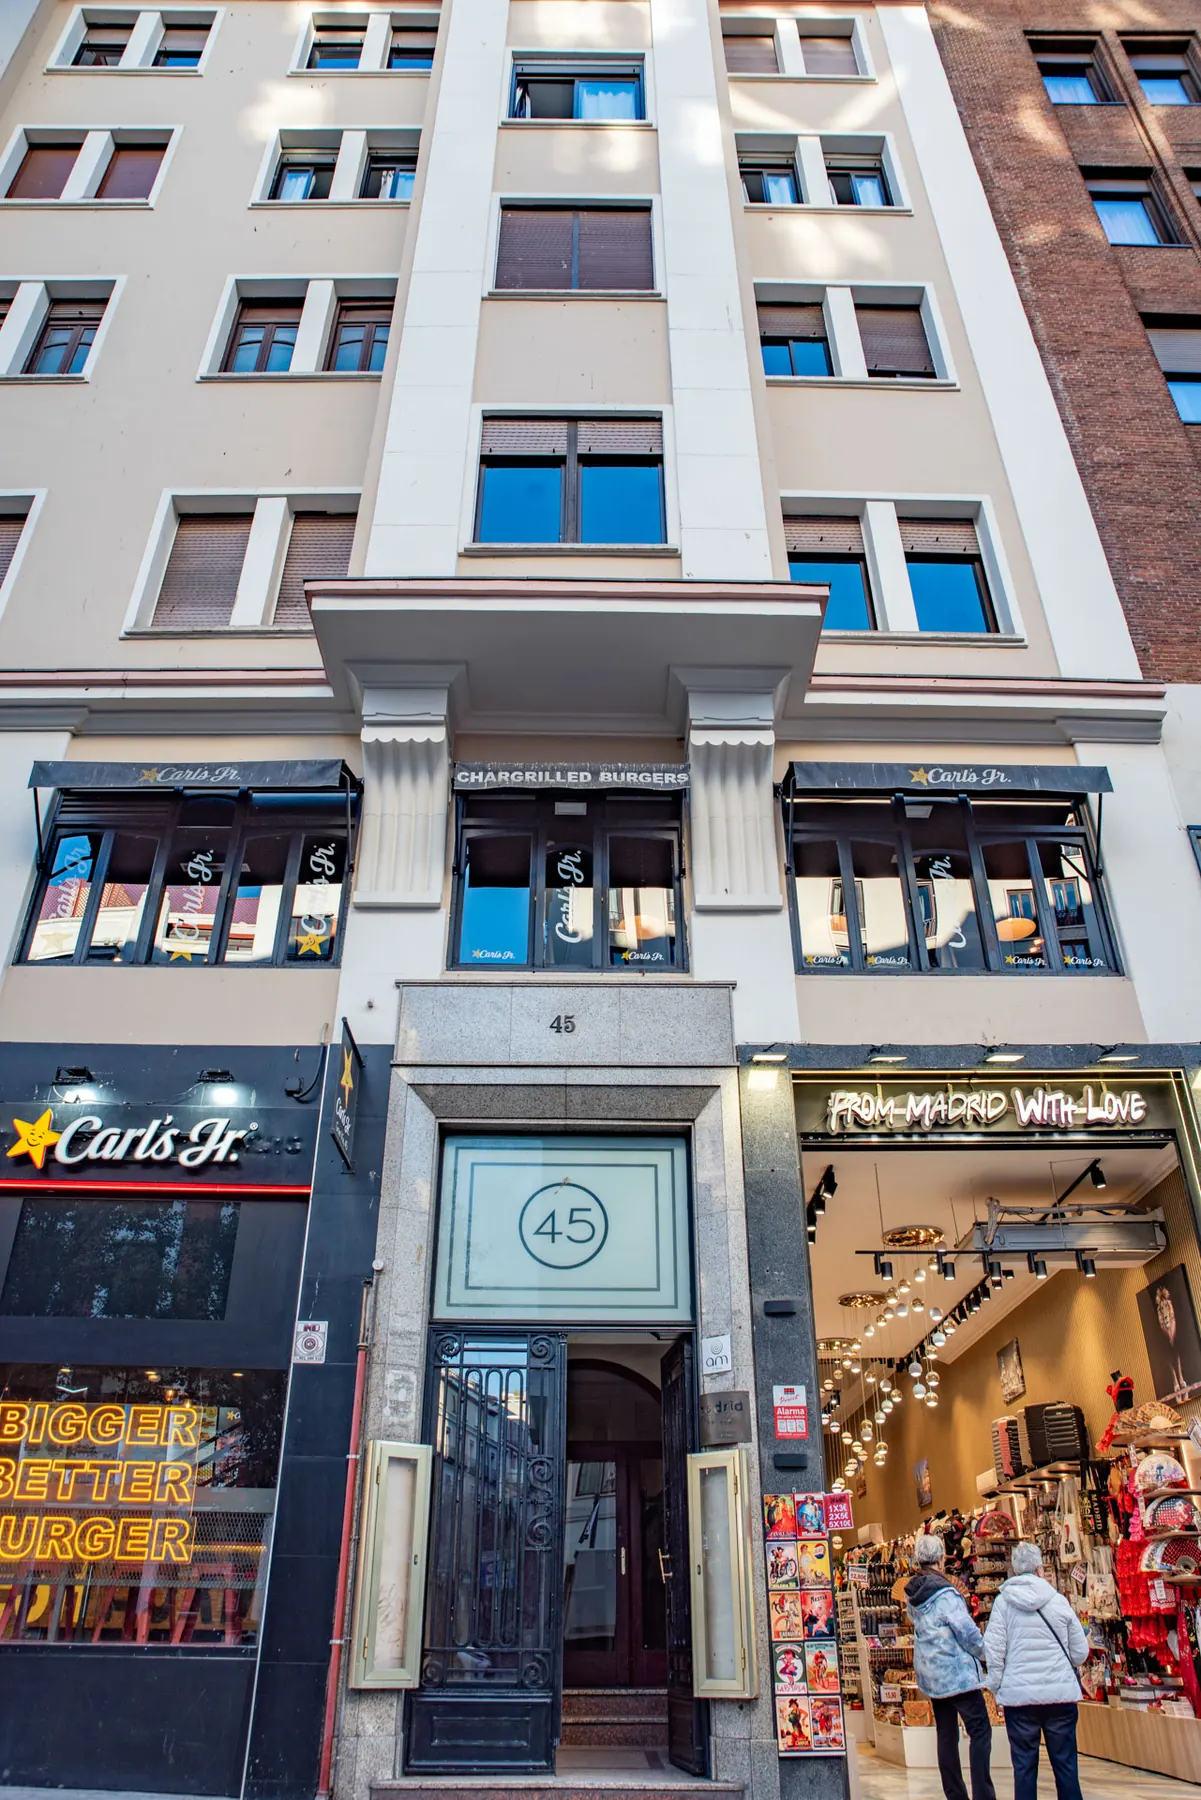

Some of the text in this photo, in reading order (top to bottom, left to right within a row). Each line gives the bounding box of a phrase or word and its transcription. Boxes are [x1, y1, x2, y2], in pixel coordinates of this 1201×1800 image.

[156, 766, 242, 783] Carl's Jr.
[456, 770, 690, 786] CHARGRILLED BURGERS
[927, 767, 1012, 785] Carl's Jr.
[309, 842, 336, 876] Jr.
[557, 849, 585, 884] Jr.
[174, 848, 214, 941] Crl's Jr.
[628, 951, 650, 960] Carl's
[549, 1014, 576, 1033] 45
[828, 1091, 896, 1132] FROM
[905, 1090, 1007, 1126] MADRID
[1086, 1083, 1146, 1125] LOVE
[54, 1113, 181, 1165] Carl's
[532, 1207, 596, 1244] 45
[706, 1354, 729, 1368] am
[0, 1404, 198, 1447] BIGGER
[776, 1407, 805, 1416] Alarma
[0, 1515, 191, 1562] URGER
